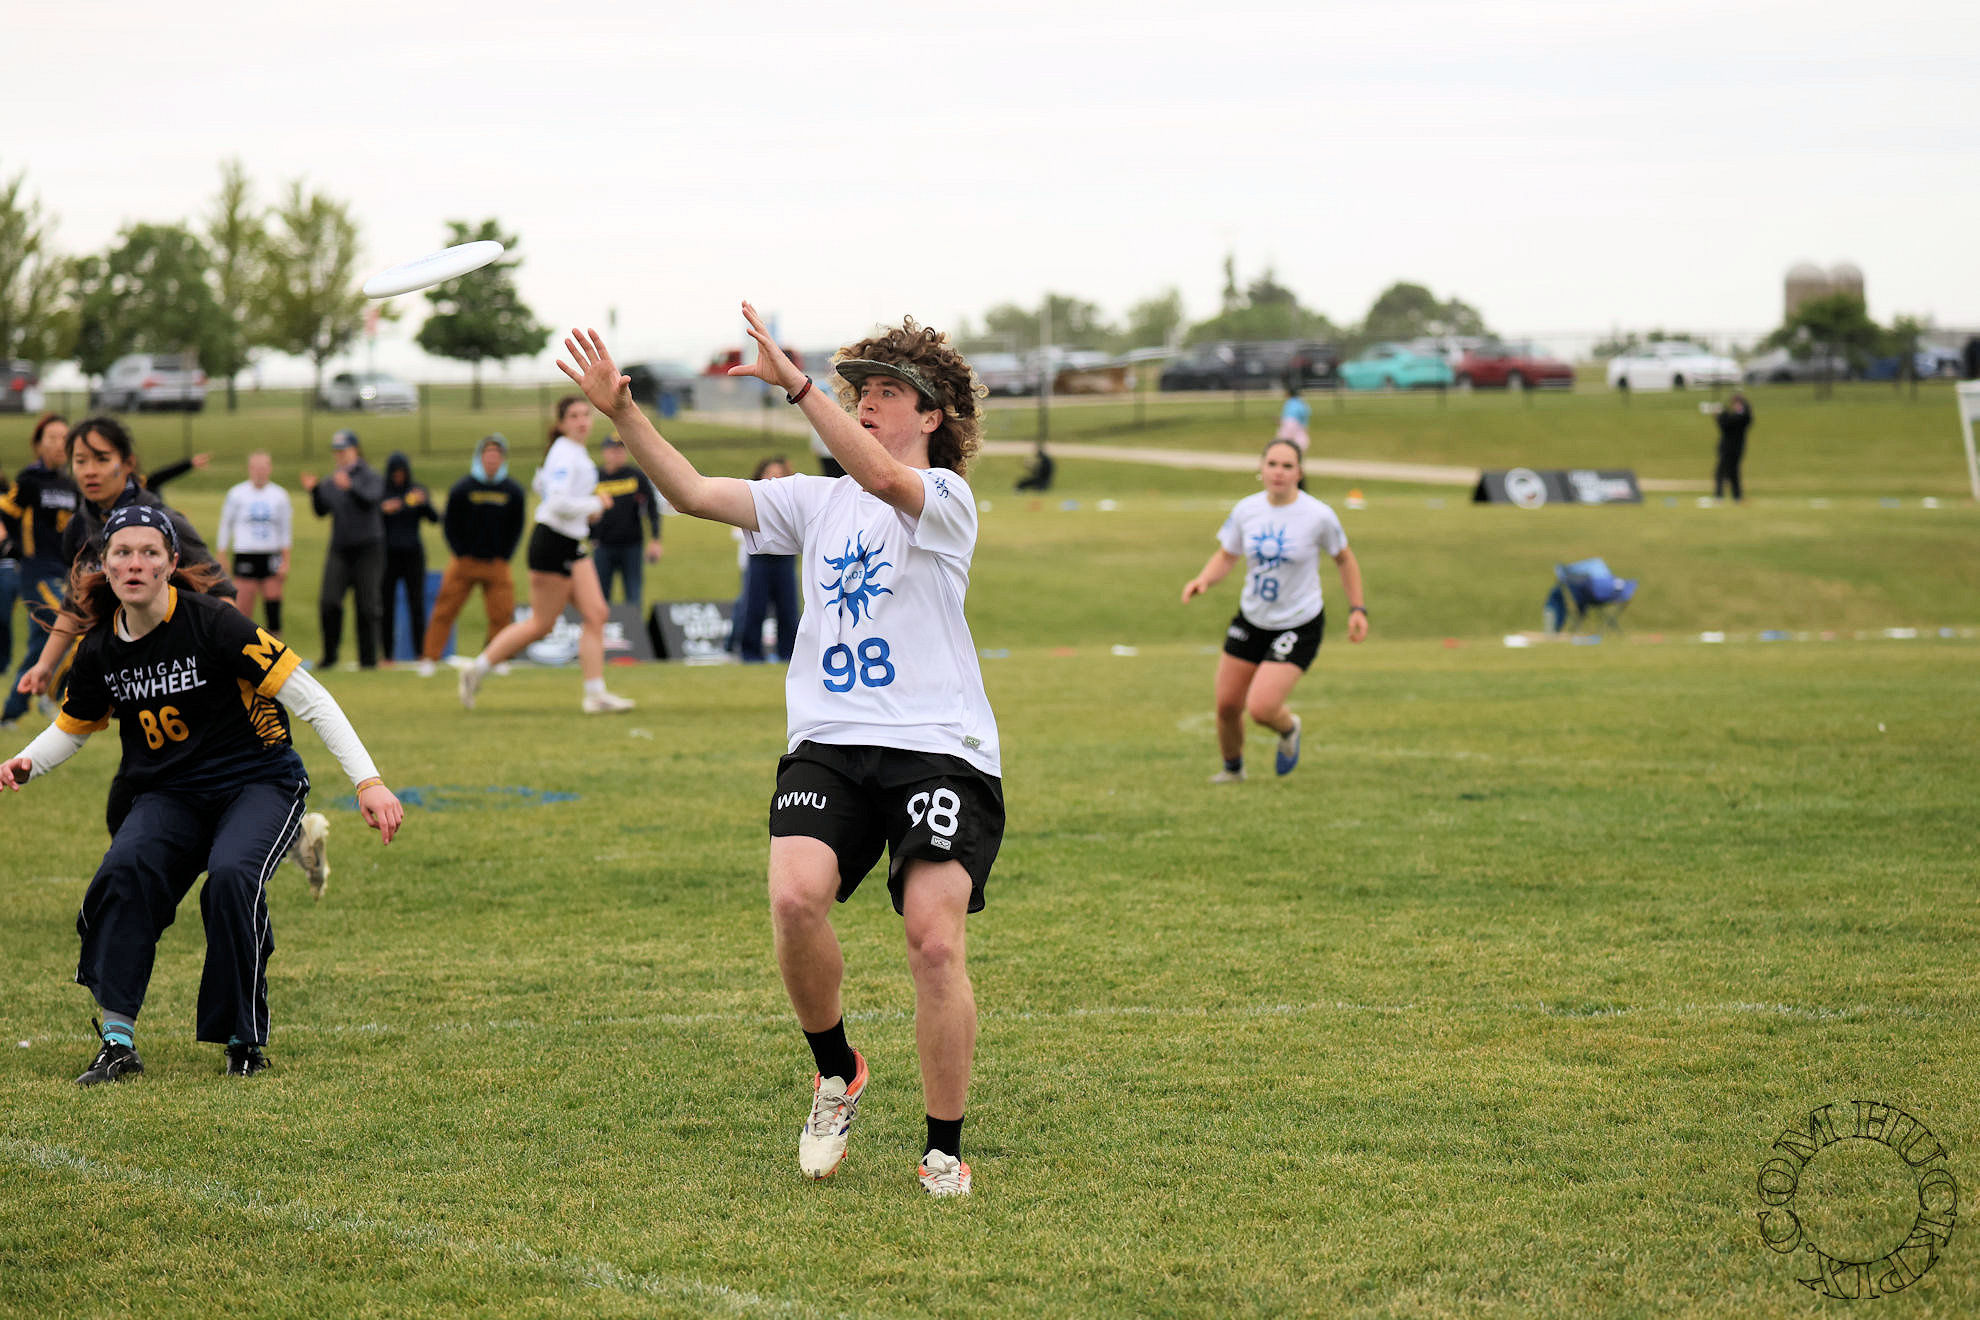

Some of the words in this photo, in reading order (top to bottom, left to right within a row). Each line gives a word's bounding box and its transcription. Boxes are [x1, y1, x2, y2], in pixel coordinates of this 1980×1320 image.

[1253, 574, 1279, 602] 18
[242, 627, 286, 671] M
[822, 637, 895, 693] 98
[138, 705, 190, 750] 86
[777, 791, 827, 810] WWU
[906, 788, 961, 837] 98
